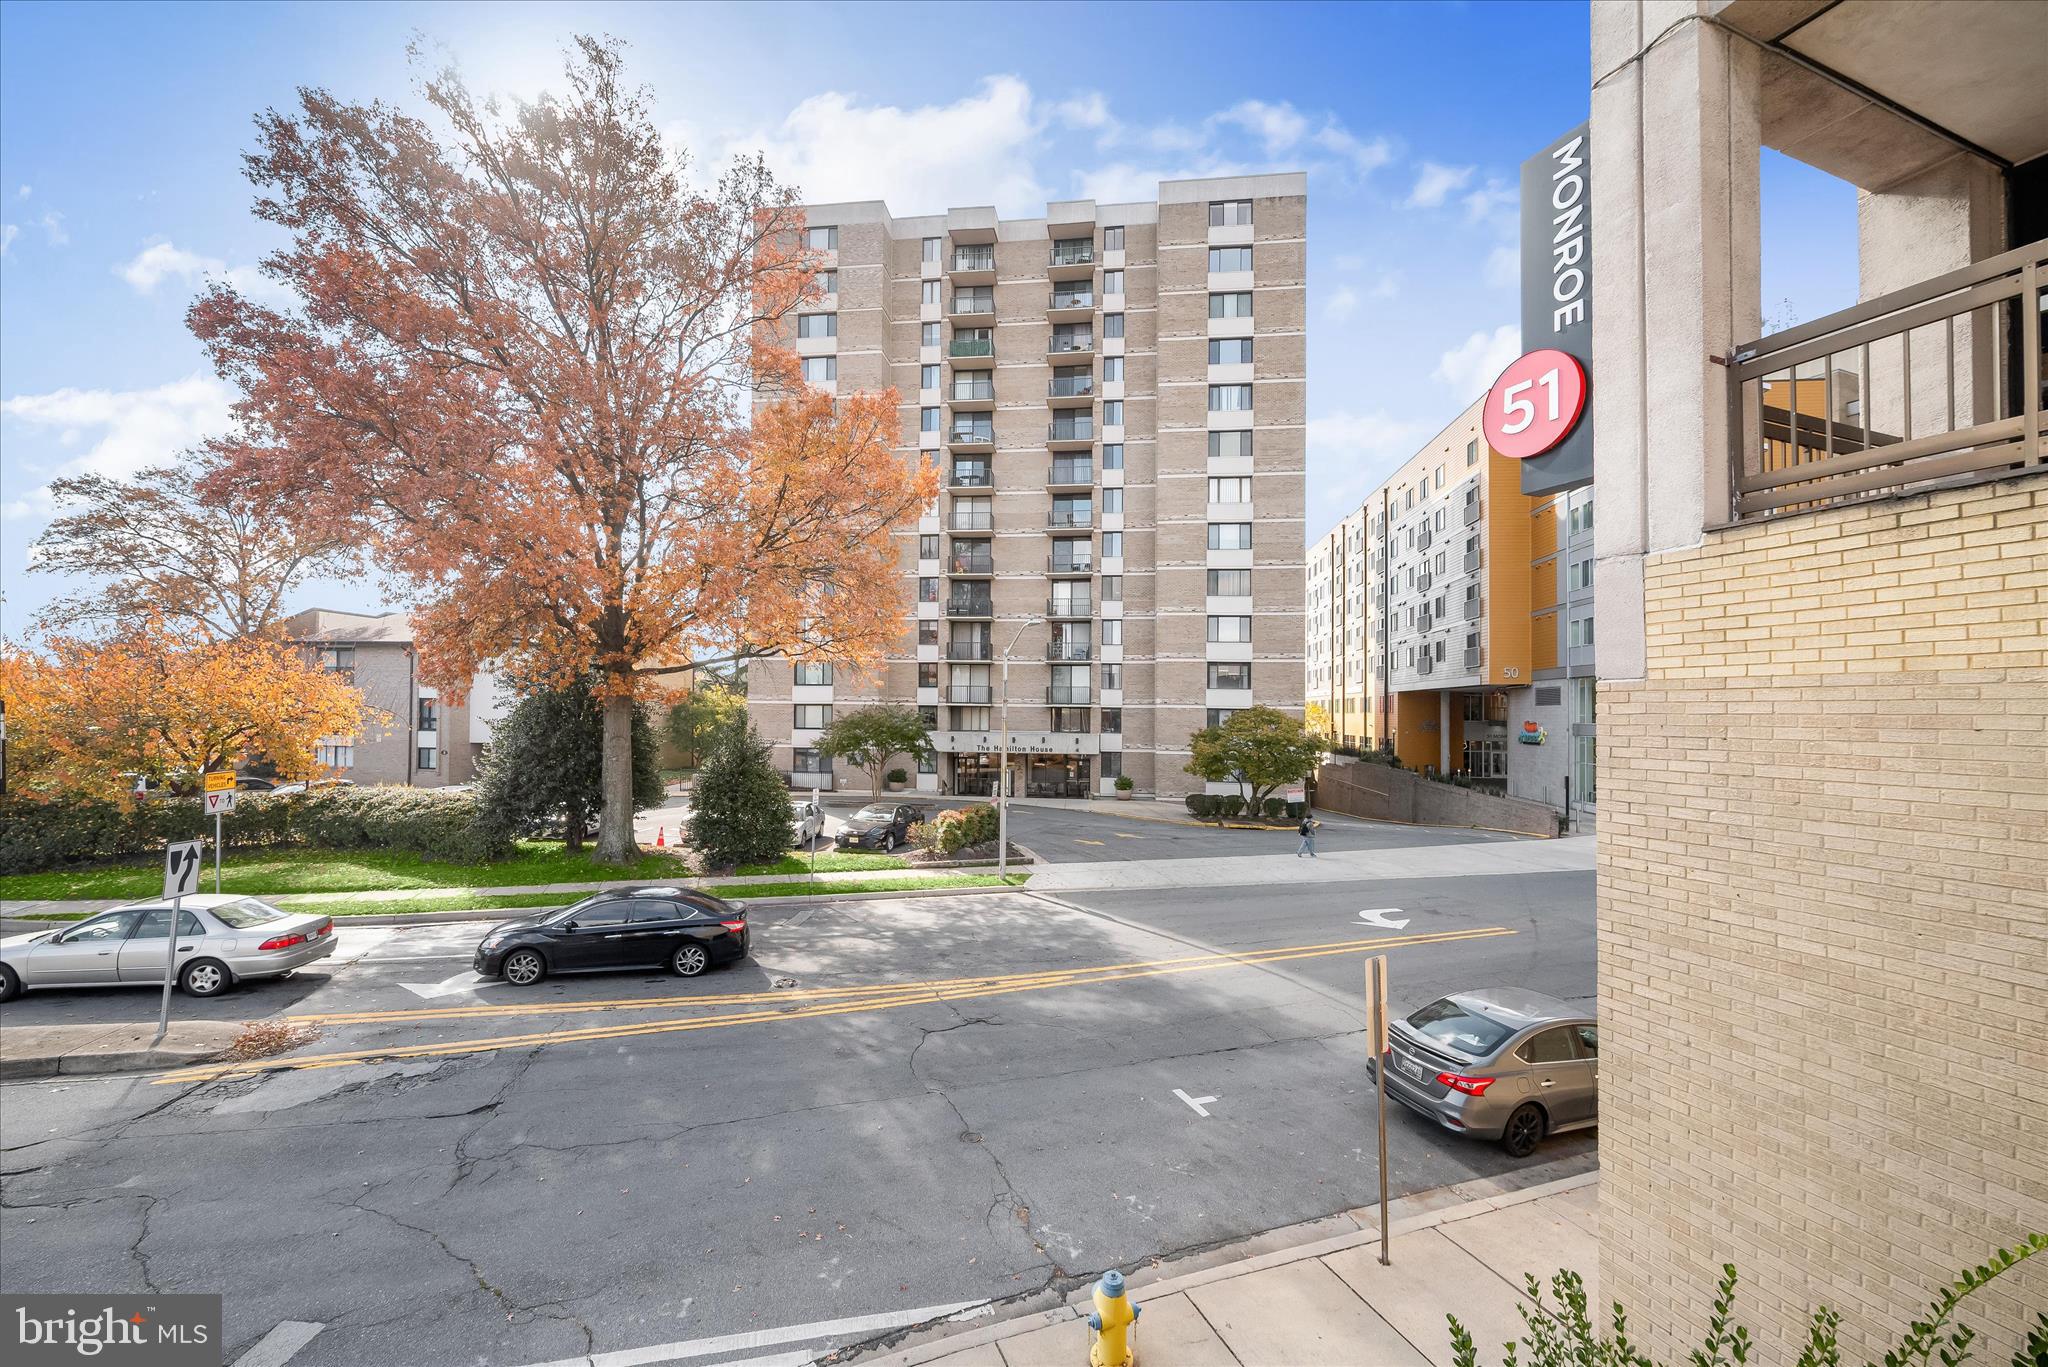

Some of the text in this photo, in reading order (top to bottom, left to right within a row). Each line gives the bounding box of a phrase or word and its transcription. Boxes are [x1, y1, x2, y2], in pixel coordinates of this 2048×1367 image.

[1552, 135, 1586, 333] MONROE
[1500, 367, 1561, 436] 51
[1503, 666, 1519, 678] 50
[977, 744, 990, 752] The
